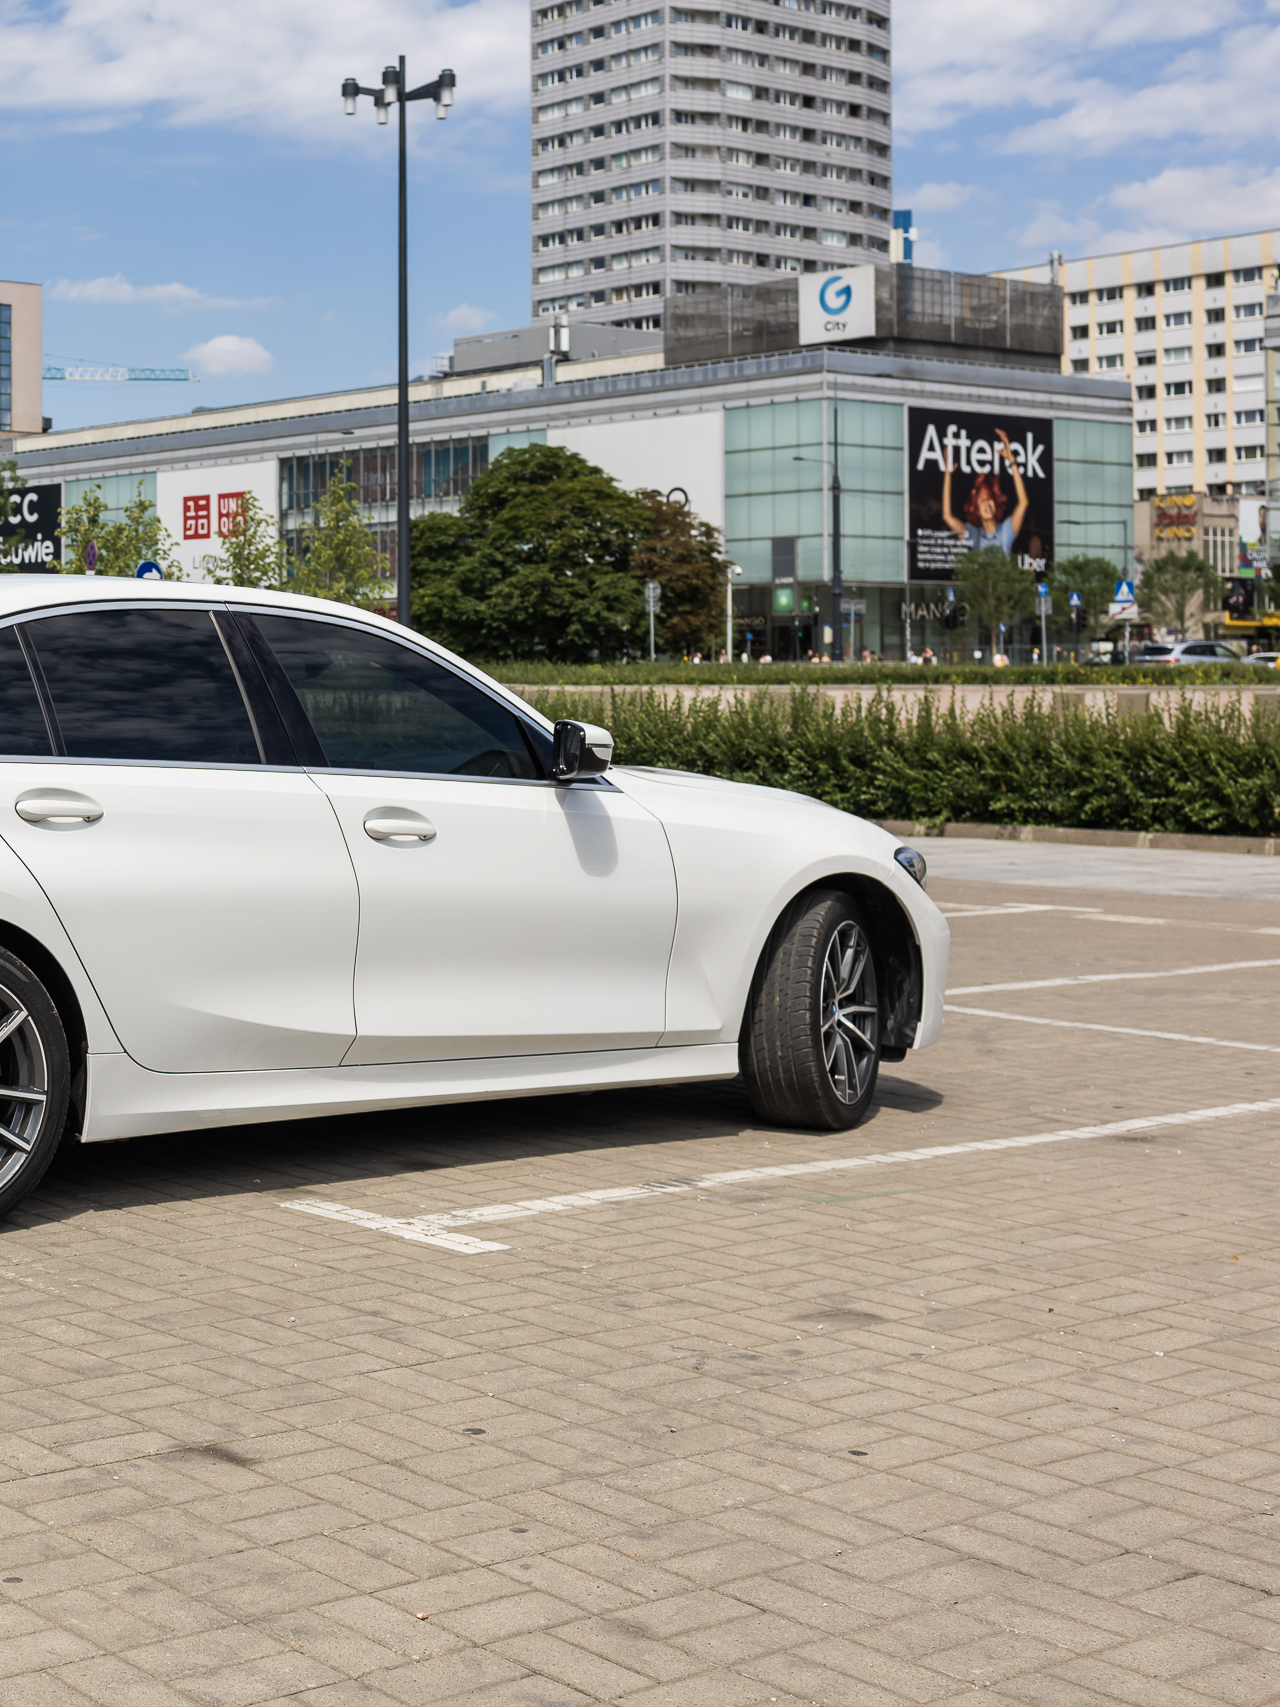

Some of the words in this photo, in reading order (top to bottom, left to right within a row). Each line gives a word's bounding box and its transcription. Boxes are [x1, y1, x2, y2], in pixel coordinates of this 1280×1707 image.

[823, 320, 848, 333] City
[916, 423, 1047, 479] Afterek
[1155, 494, 1197, 509] KINO
[1155, 525, 1197, 539] KINO
[1017, 554, 1047, 572] Uber
